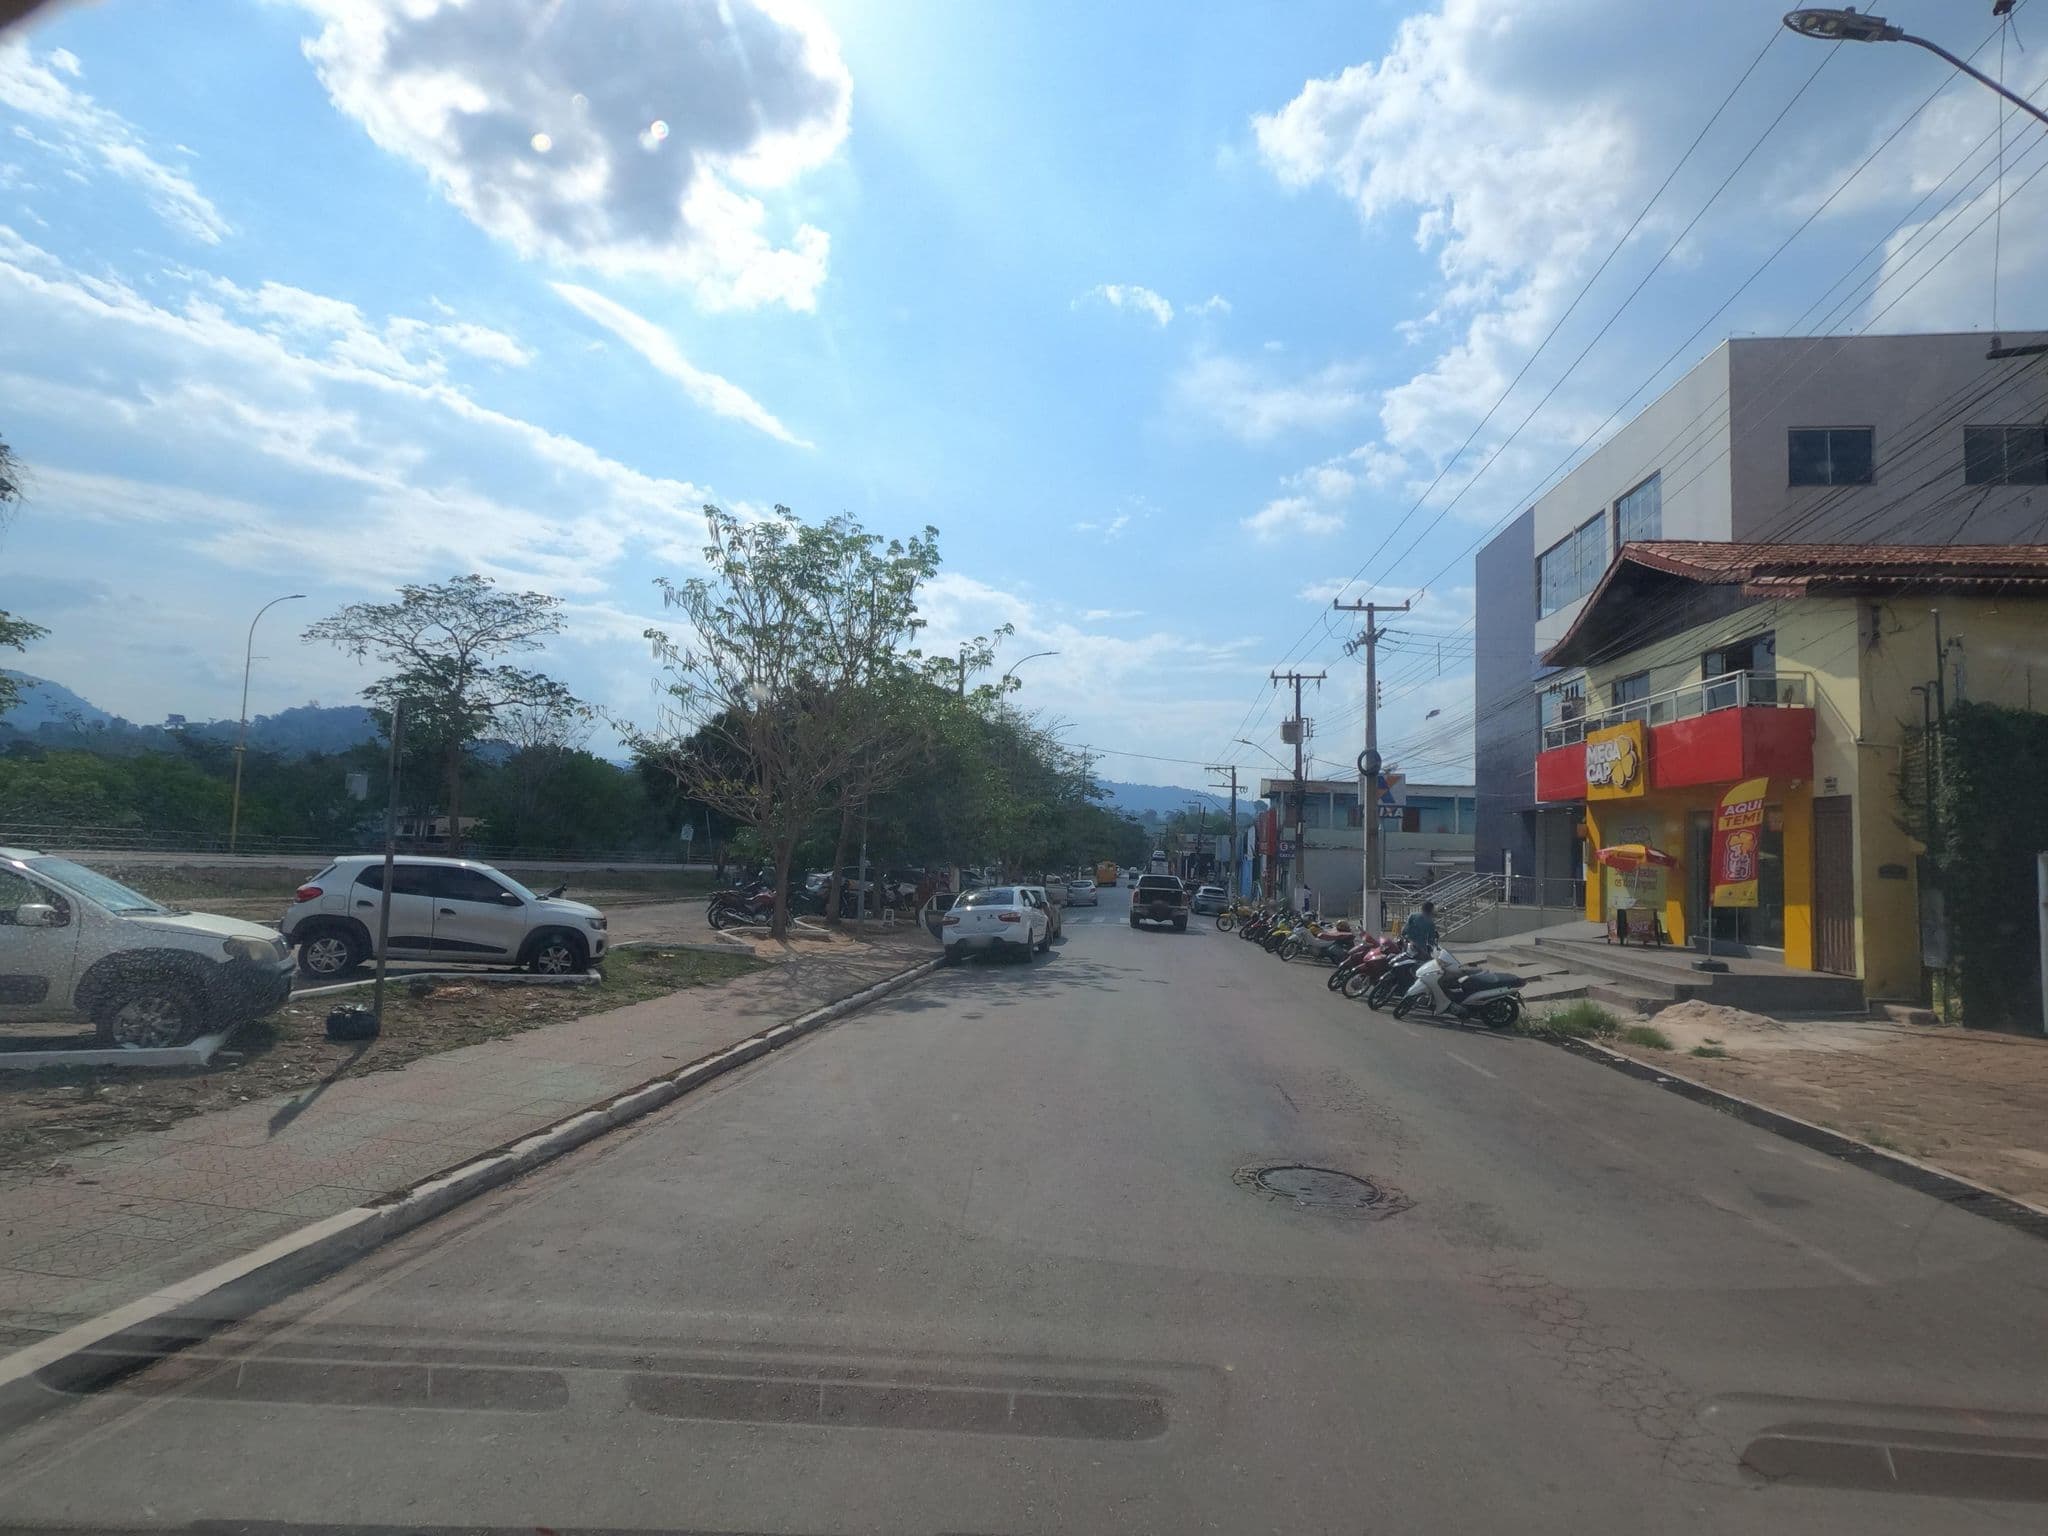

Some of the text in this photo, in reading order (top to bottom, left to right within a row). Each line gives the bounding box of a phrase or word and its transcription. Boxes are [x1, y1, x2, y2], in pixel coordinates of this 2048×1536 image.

[1587, 741, 1621, 766] MEGA
[1587, 762, 1611, 783] CAP
[1725, 800, 1762, 816] AQUI
[1726, 812, 1762, 828] TEM!
